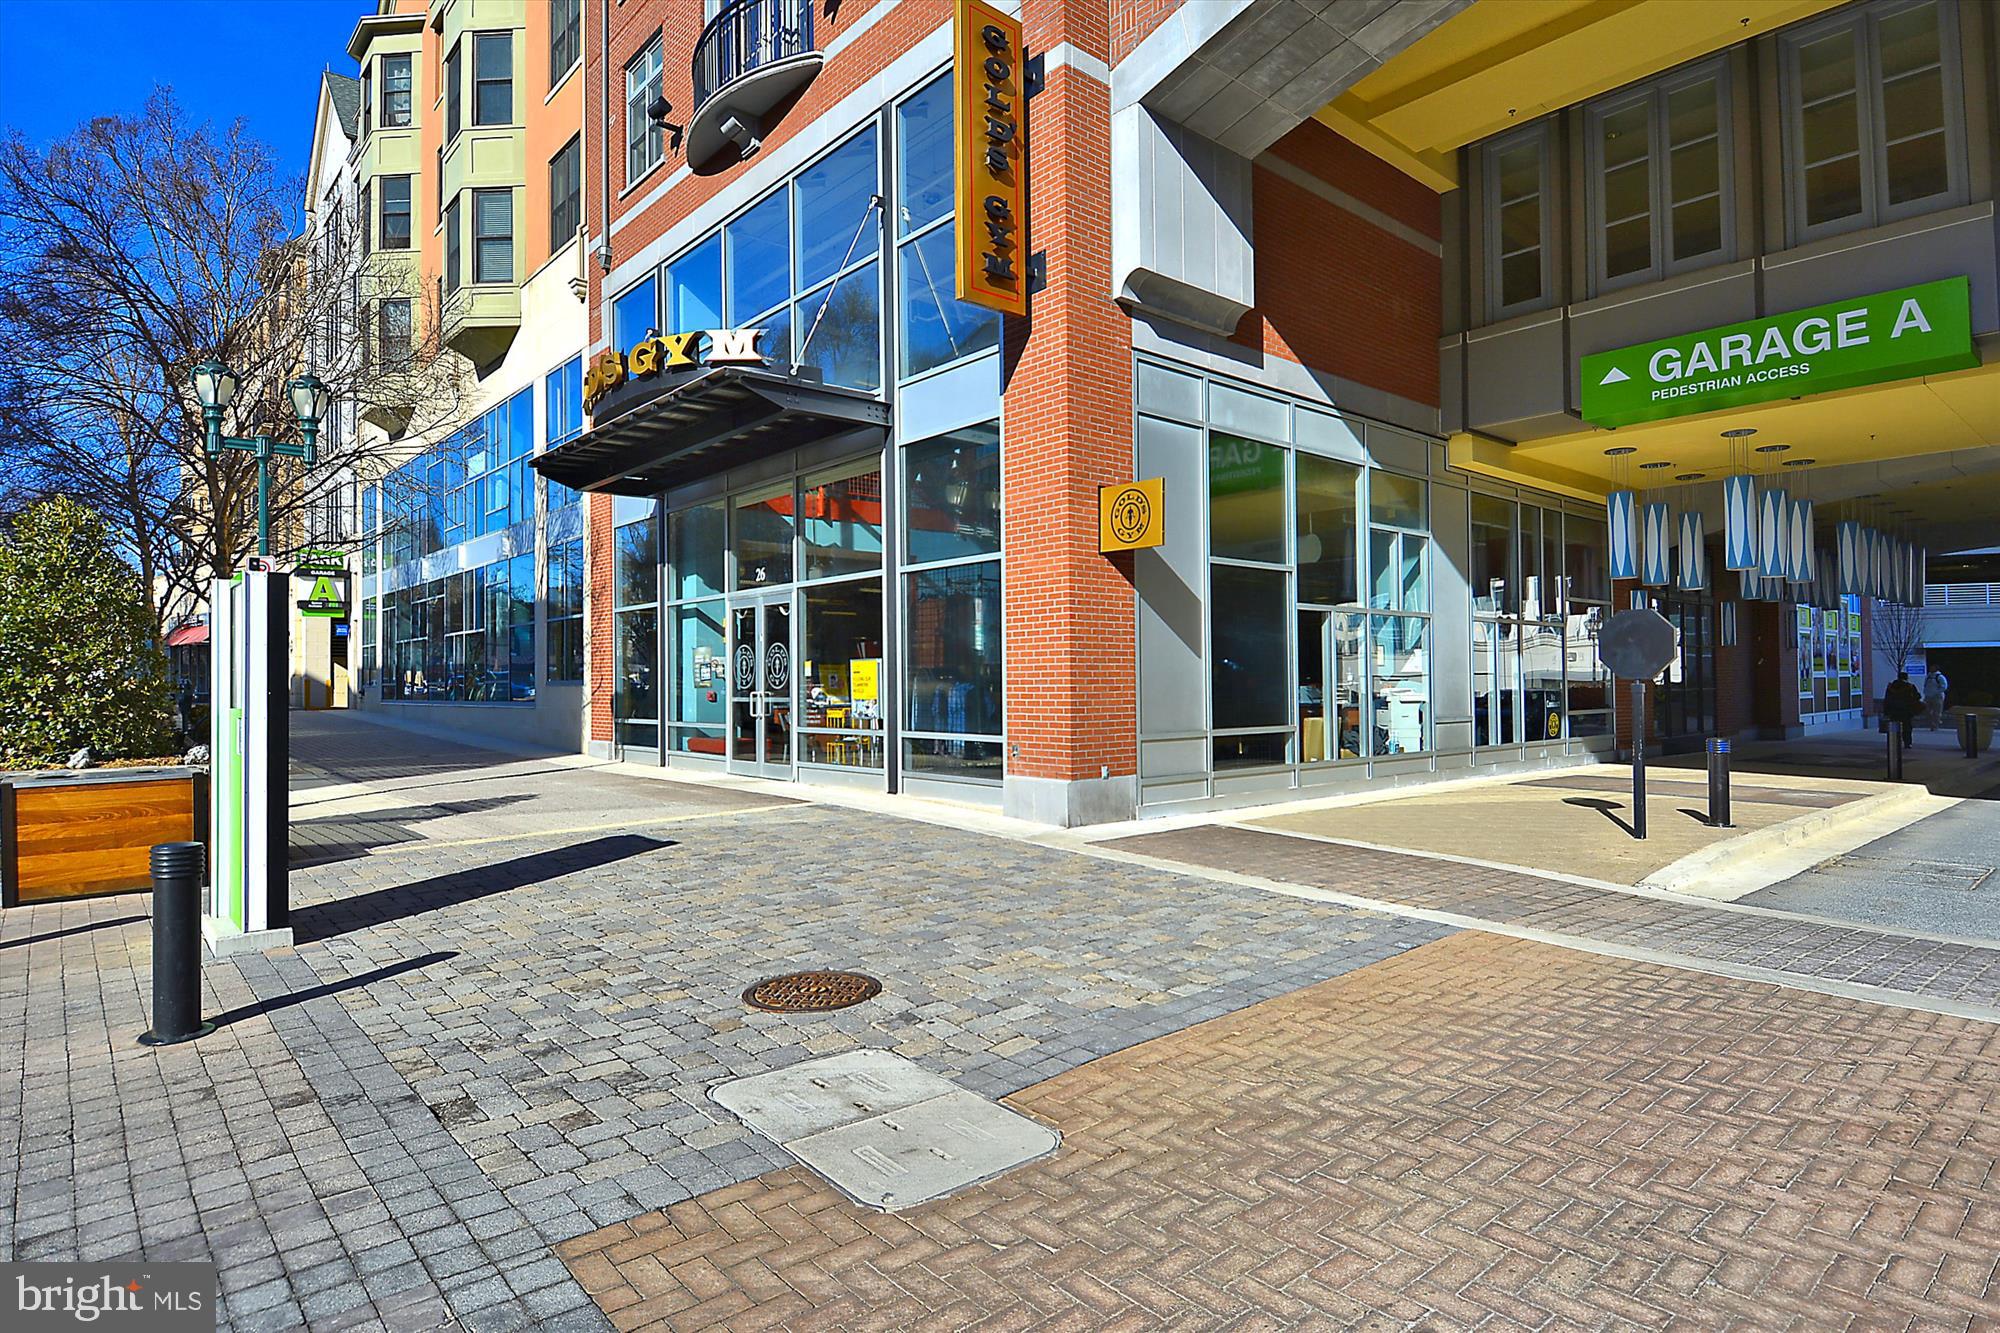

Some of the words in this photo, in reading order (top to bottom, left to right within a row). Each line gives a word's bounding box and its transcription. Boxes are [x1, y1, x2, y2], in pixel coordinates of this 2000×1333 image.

[982, 195, 1016, 281] GYM
[628, 328, 767, 376] GYM
[1648, 308, 1870, 383] GARAGE
[1890, 298, 1932, 339] A
[1651, 375, 1741, 401] PEDESTRIAN
[1745, 362, 1810, 384] ACCESS
[1117, 522, 1144, 538] GYM
[308, 576, 339, 602] A
[755, 566, 766, 582] 26
